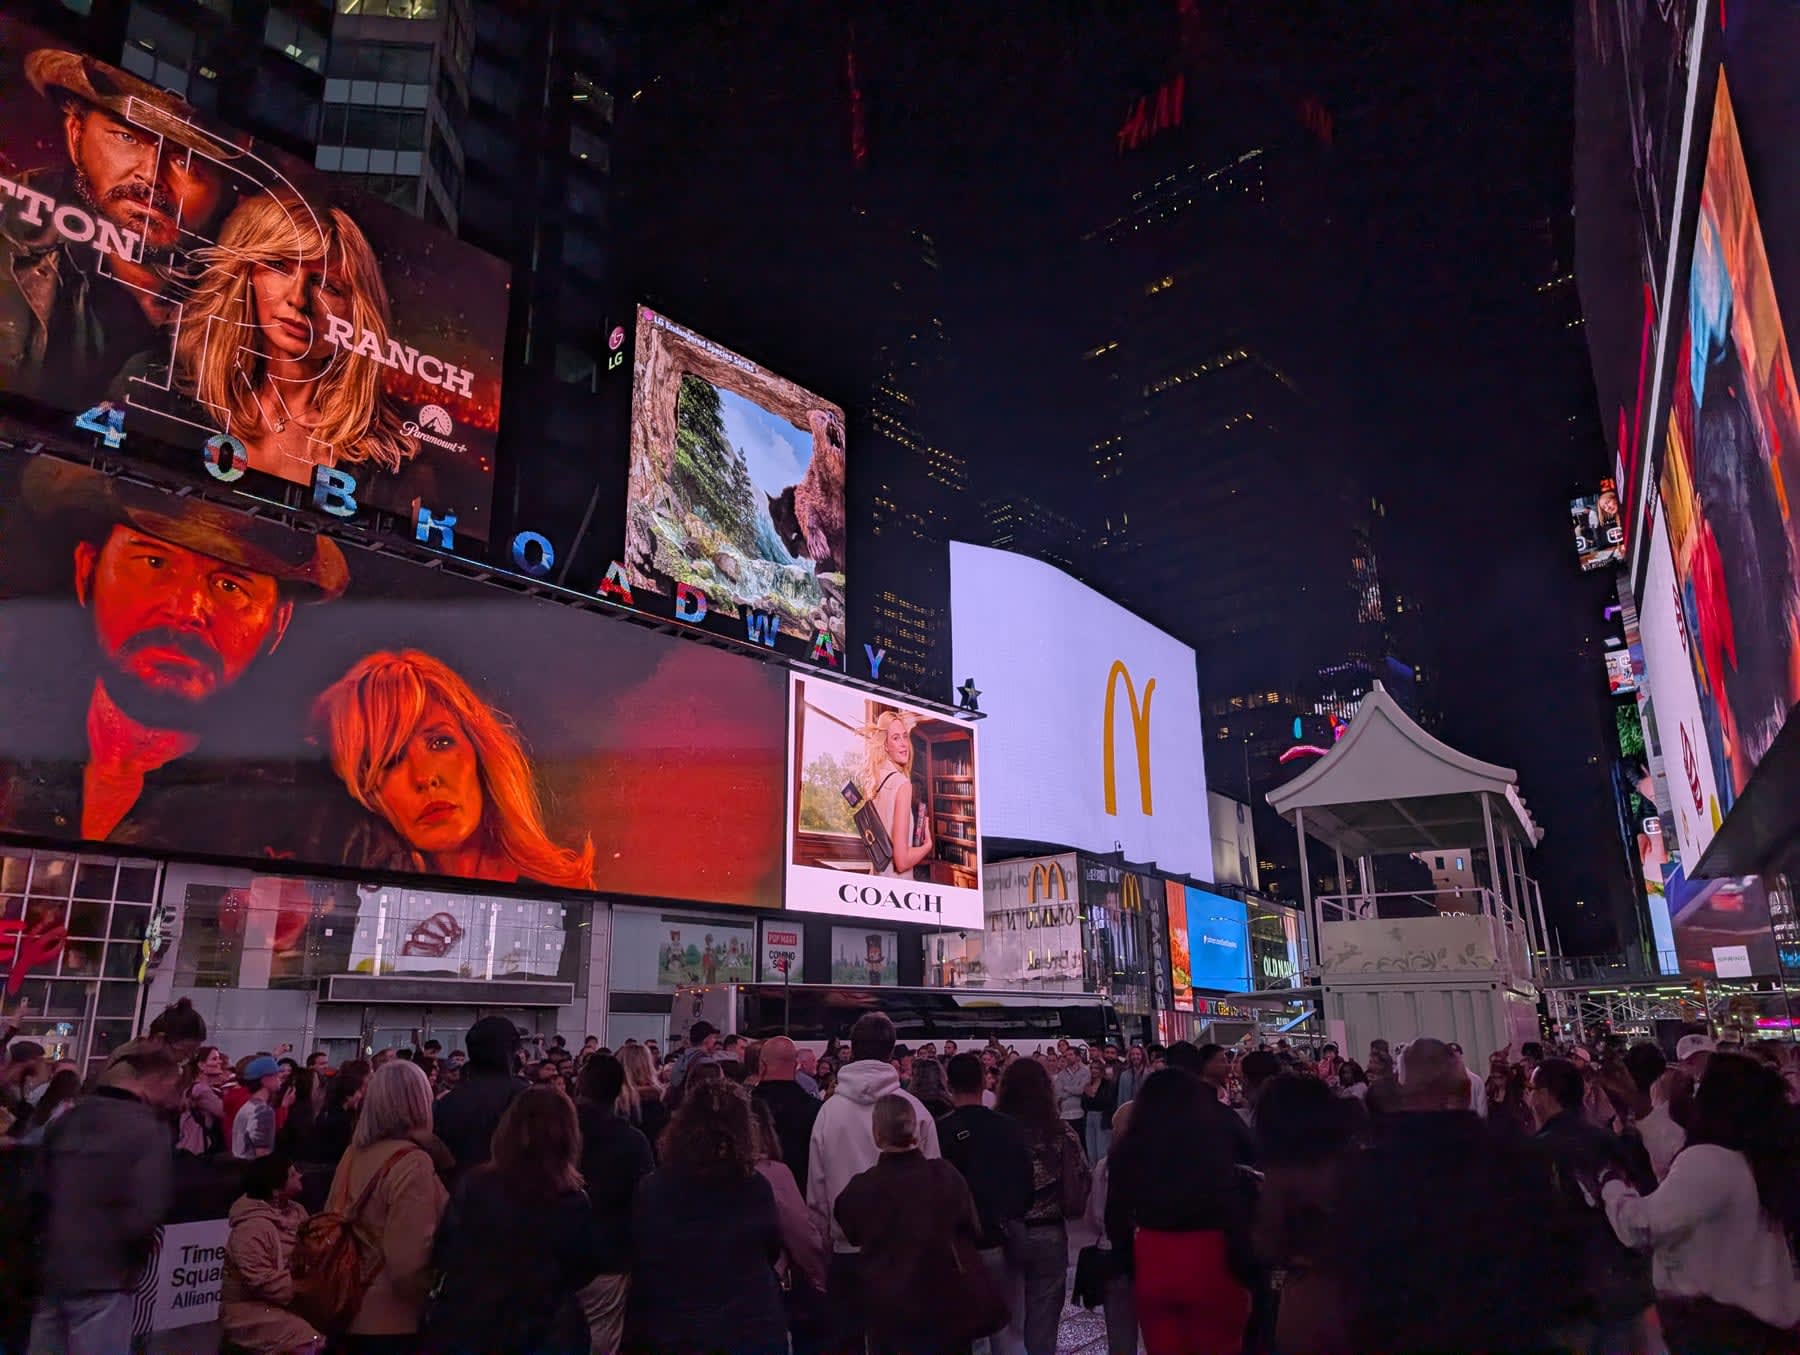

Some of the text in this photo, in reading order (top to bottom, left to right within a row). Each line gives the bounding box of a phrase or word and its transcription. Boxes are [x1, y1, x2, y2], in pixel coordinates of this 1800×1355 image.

[324, 314, 474, 399] RANCH
[608, 351, 623, 370] LG
[400, 421, 467, 452] Paramount+
[838, 884, 943, 912] COACH
[772, 960, 791, 969] SN
[1263, 955, 1278, 978] OLD
[181, 1245, 225, 1265] Time
[171, 1266, 224, 1287] Squar
[171, 1290, 222, 1309] Allianc
